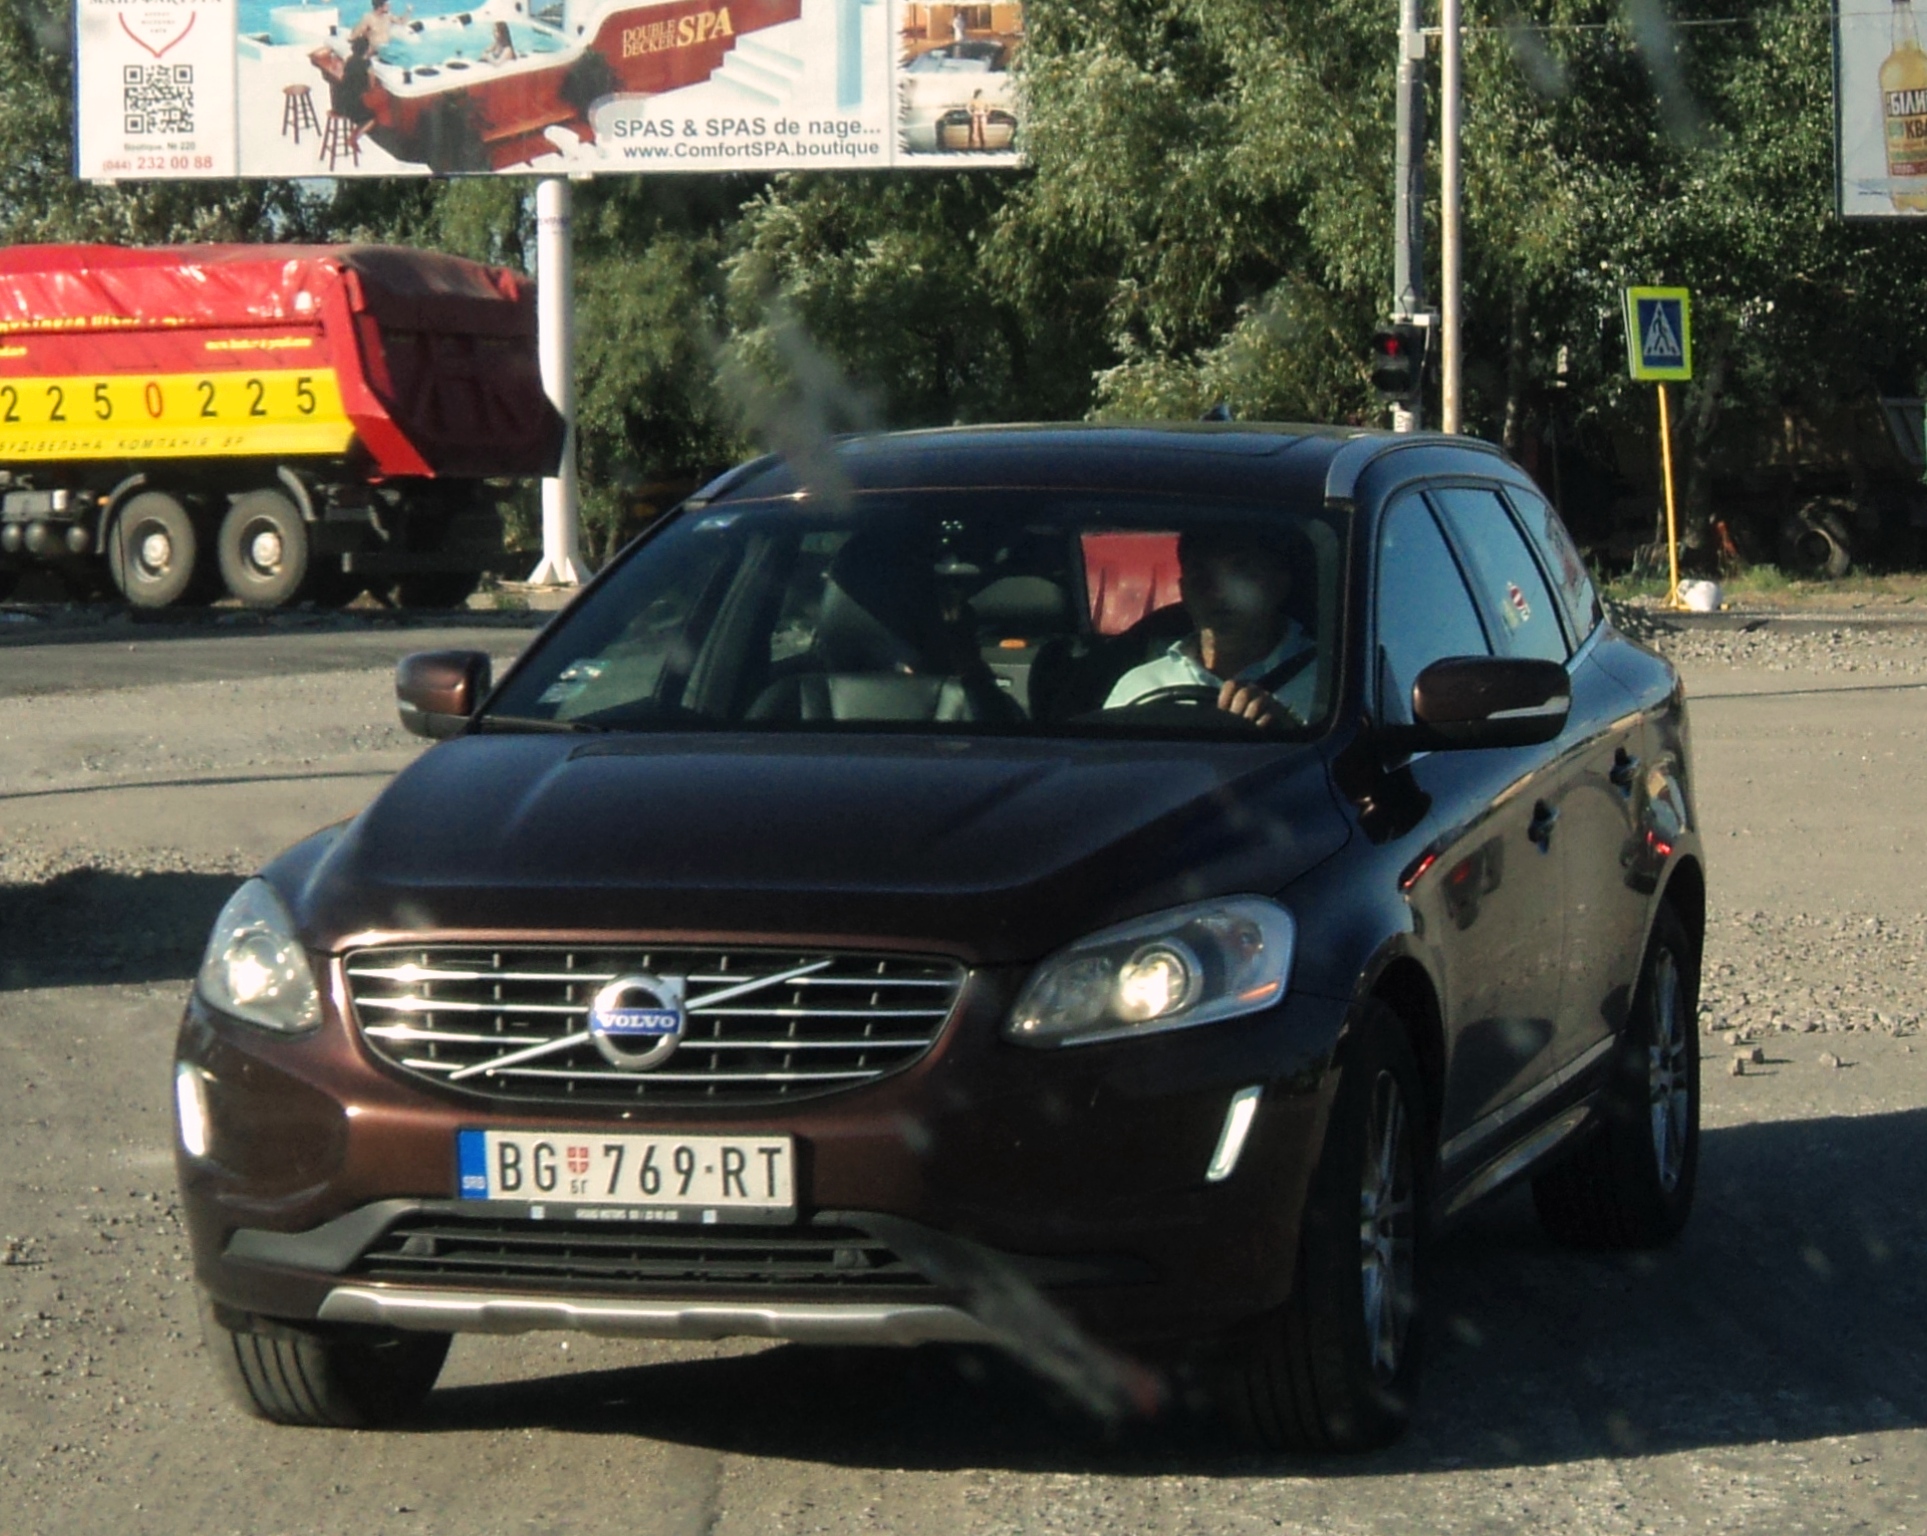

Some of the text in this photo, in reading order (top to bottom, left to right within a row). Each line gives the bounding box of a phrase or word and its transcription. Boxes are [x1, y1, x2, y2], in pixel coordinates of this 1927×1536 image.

[623, 20, 676, 41] DOUBLE
[677, 6, 734, 48] SPA
[623, 36, 677, 58] DECKER
[1890, 90, 1927, 116] БІЛИ
[613, 117, 882, 139] SPAS & SPAS de nage...
[623, 139, 880, 158] www.ComfortSPA.boutique
[102, 155, 213, 172] (044) 232 00 88
[598, 1014, 677, 1029] VOLVO
[497, 1140, 557, 1192] BG
